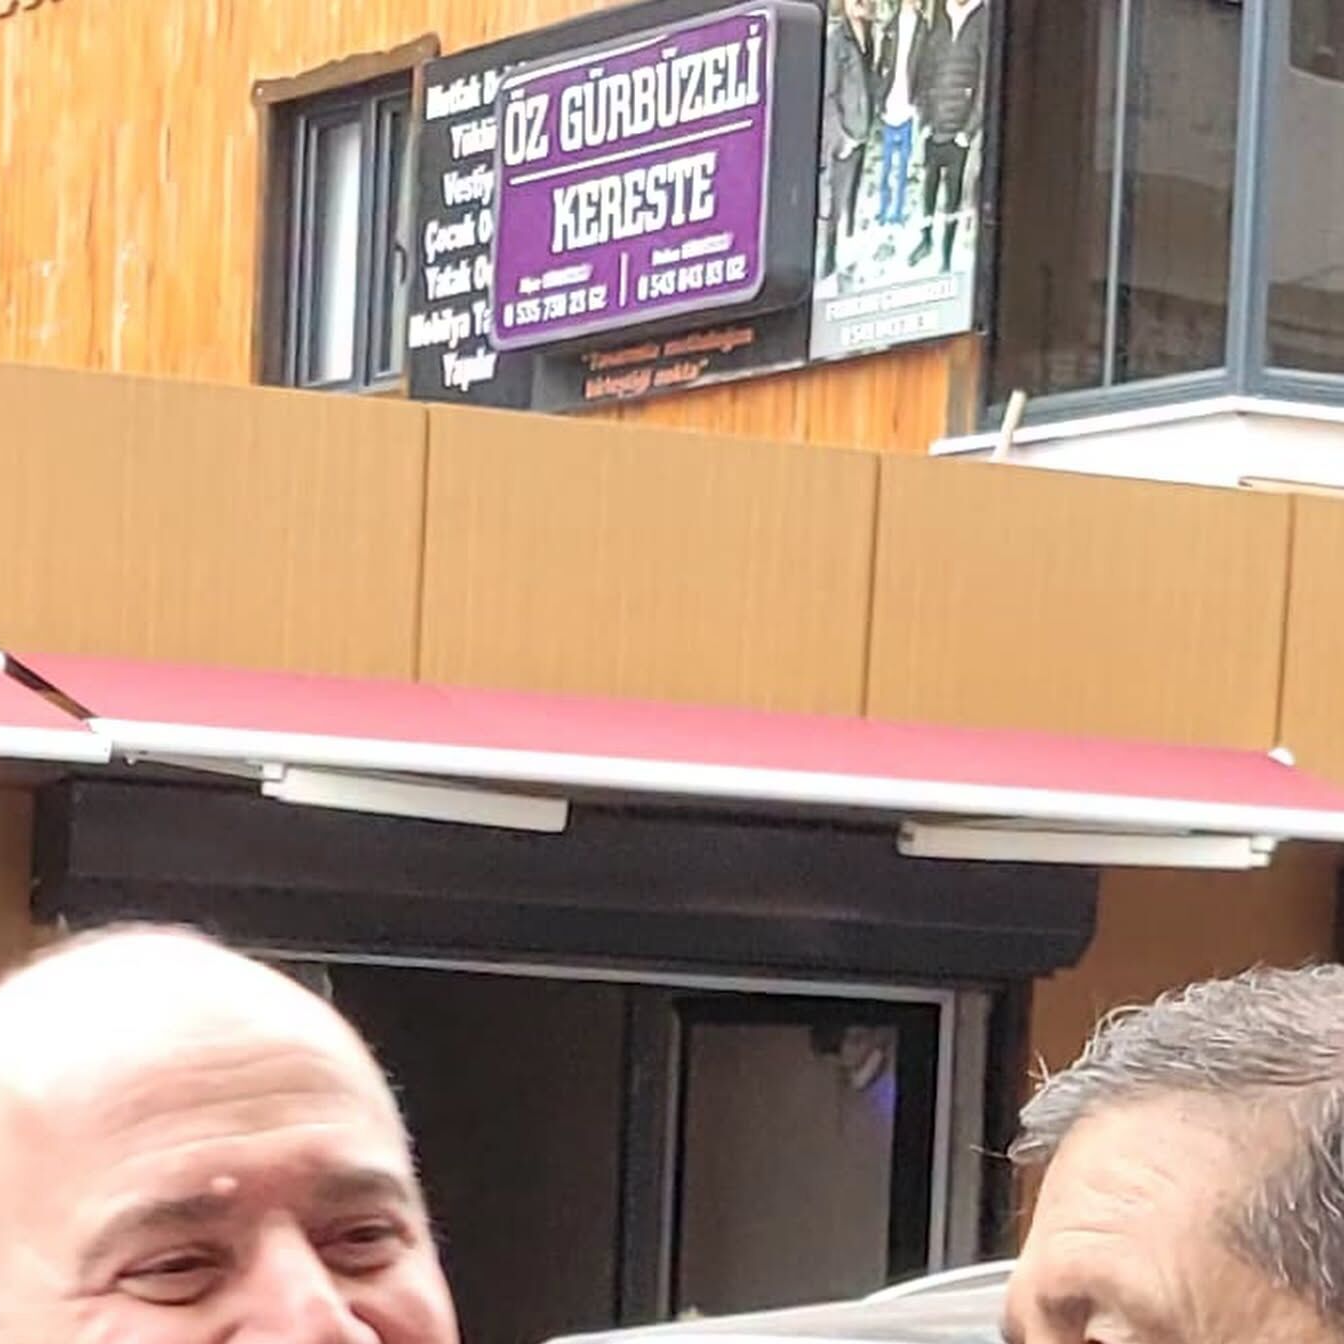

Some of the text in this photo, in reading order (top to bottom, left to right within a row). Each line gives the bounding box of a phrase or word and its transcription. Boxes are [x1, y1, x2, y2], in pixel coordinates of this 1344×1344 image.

[504, 88, 550, 166] ÖZ
[559, 25, 762, 152] GÜRBÜZELİ
[443, 164, 494, 206] Vestiy
[552, 151, 718, 253] KERESTE
[425, 258, 472, 301] Yatak
